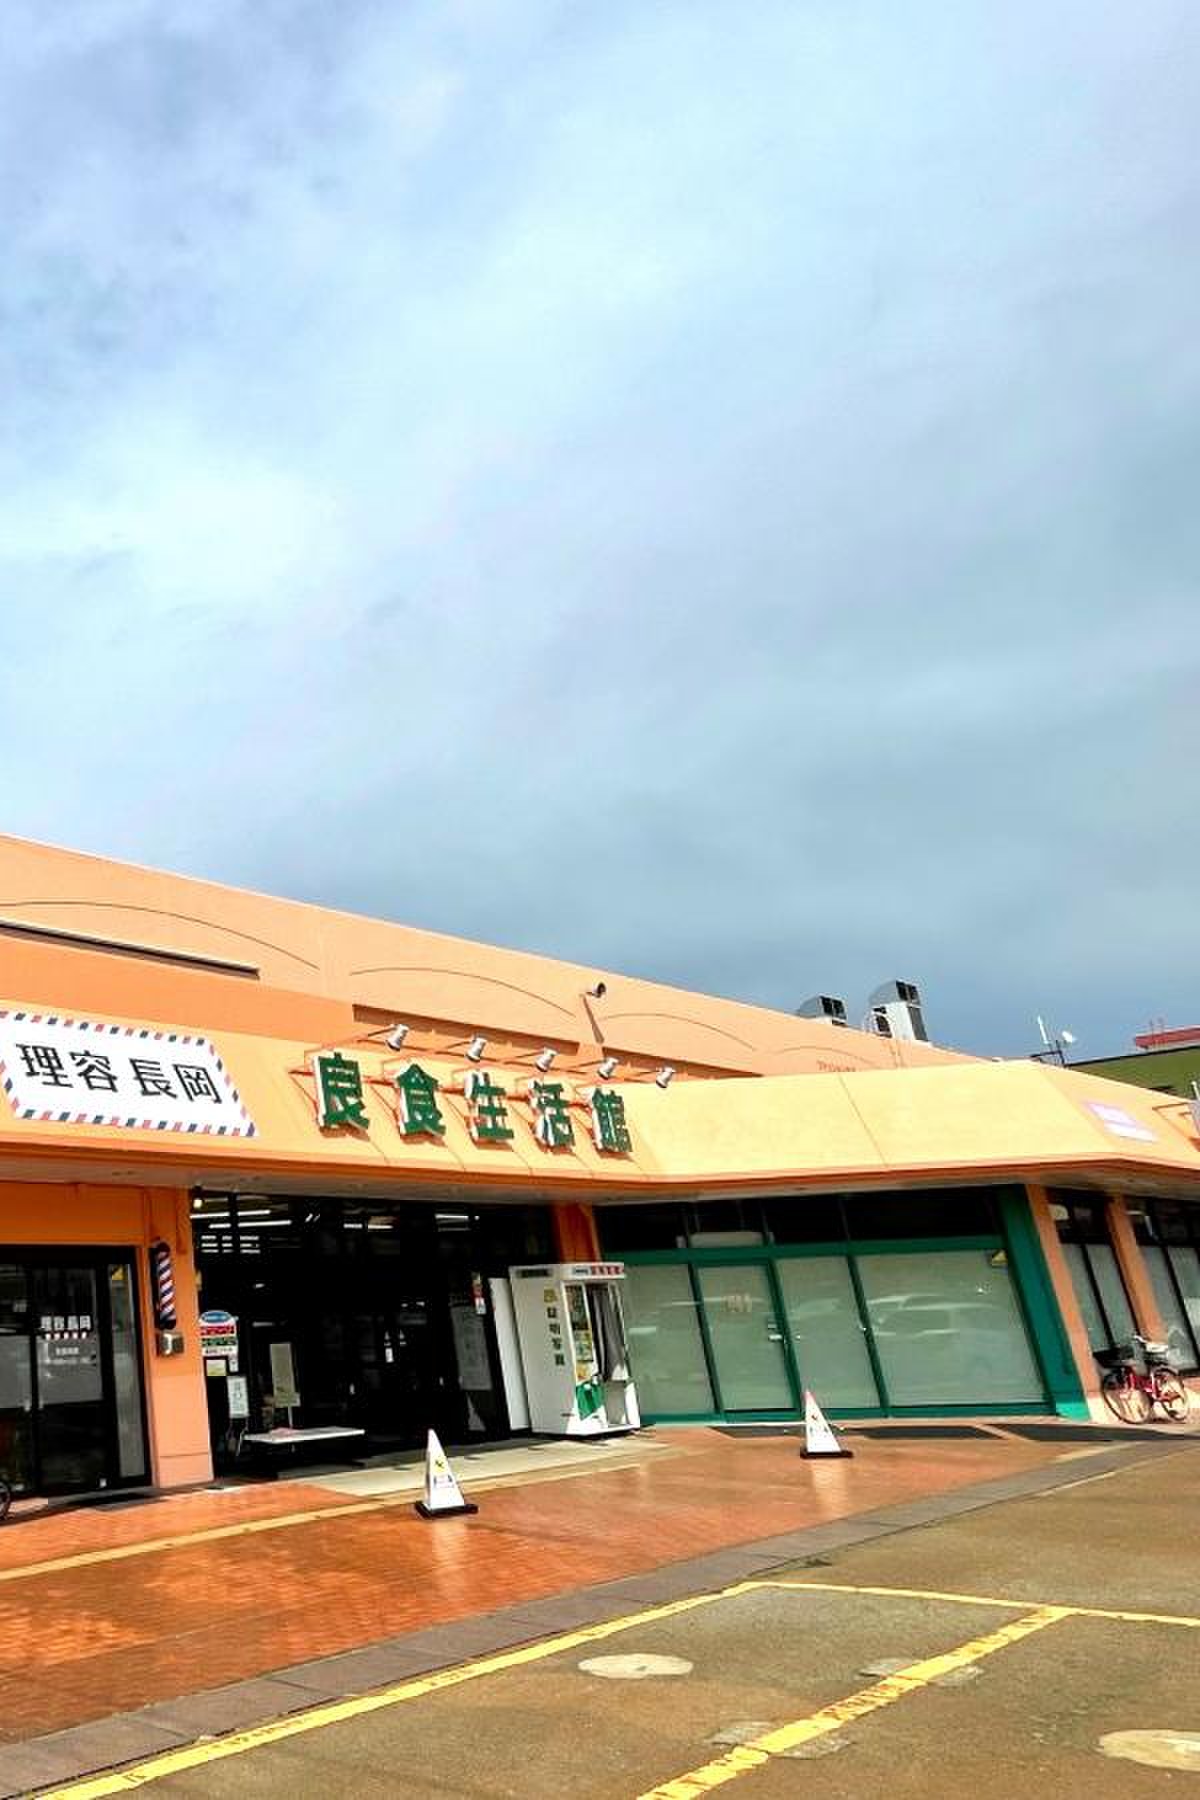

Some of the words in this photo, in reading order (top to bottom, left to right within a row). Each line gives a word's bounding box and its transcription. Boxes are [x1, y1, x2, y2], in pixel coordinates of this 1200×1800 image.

[313, 1051, 632, 1152] 良食生活館
